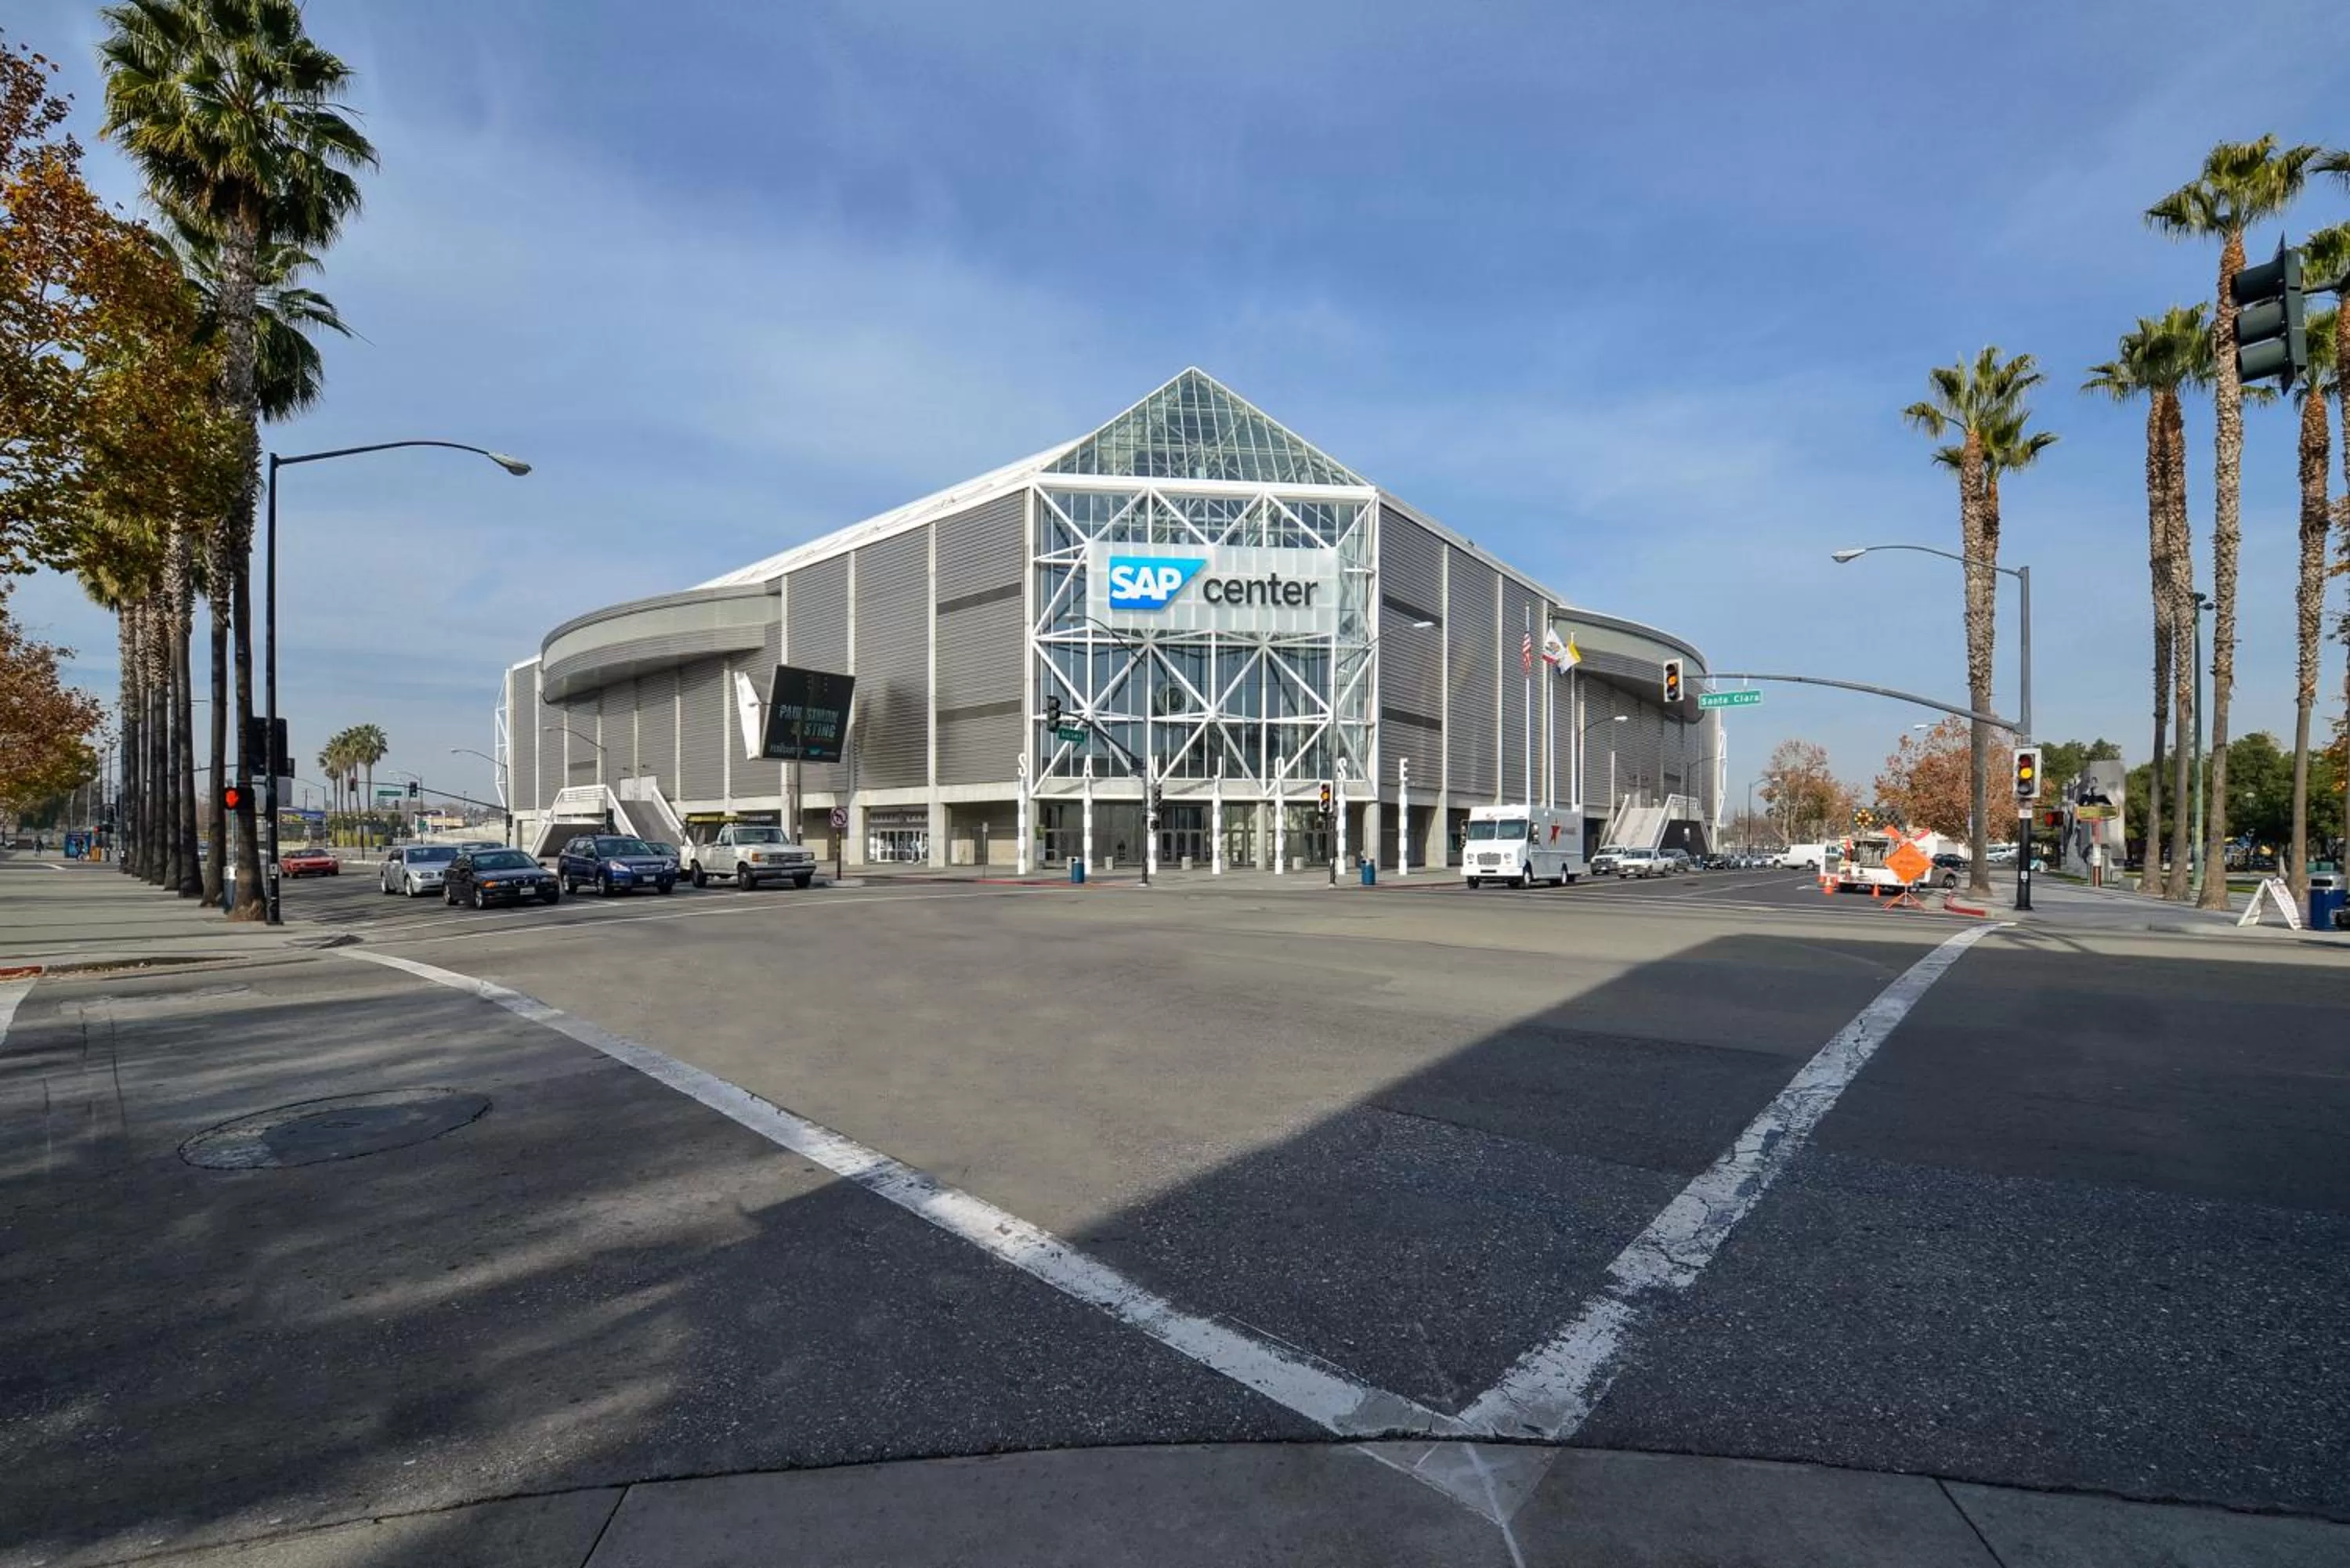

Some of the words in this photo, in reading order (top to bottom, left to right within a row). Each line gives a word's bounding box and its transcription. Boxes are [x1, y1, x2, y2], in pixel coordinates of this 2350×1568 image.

[1111, 565, 1182, 601] SAP
[1202, 572, 1318, 606] center
[1701, 695, 1729, 706] Santa
[1734, 694, 1759, 703] Clara
[804, 722, 837, 739] STING
